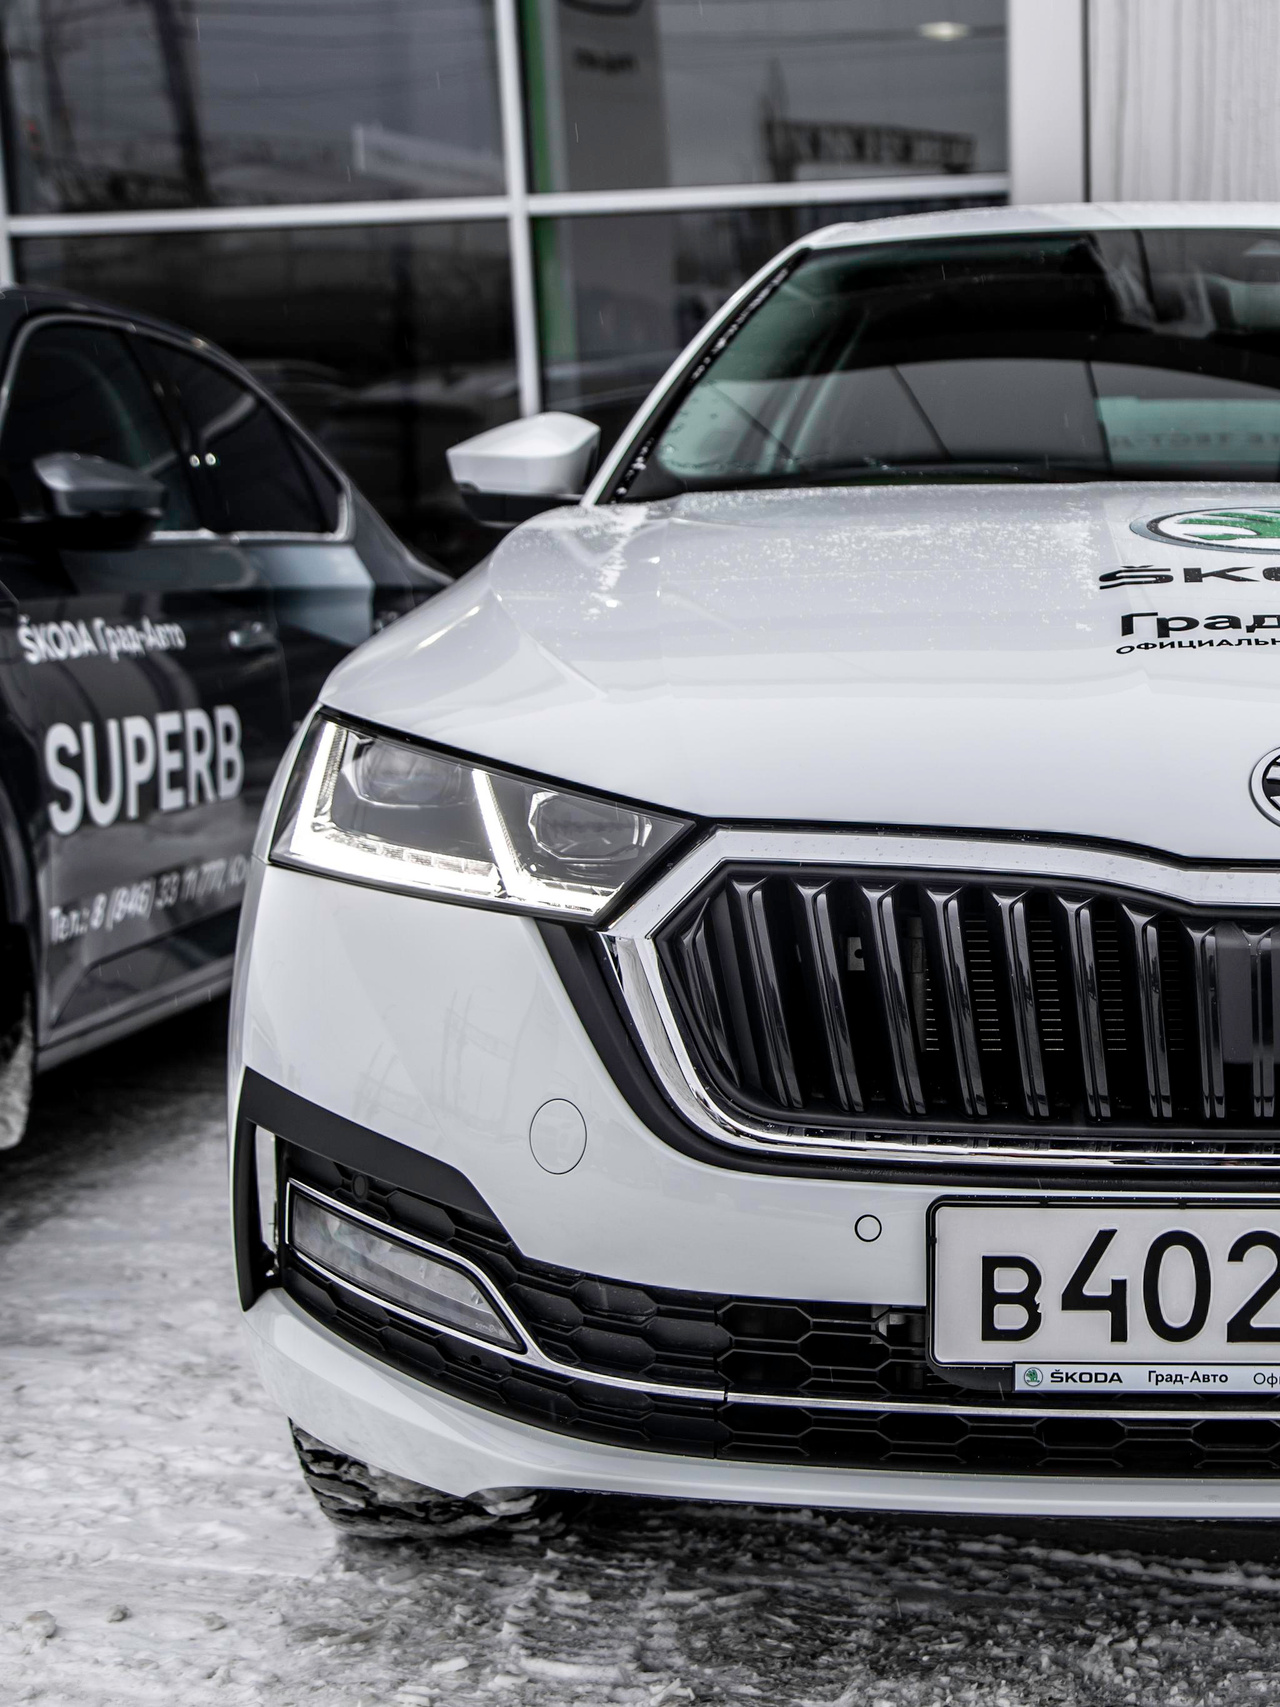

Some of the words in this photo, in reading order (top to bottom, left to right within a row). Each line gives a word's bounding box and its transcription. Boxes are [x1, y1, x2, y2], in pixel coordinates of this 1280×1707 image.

[17, 614, 98, 664] ŠKODA
[92, 615, 187, 663] Град-Авто
[44, 704, 245, 835] SUPERB
[1050, 1369, 1123, 1384] ŠKODA
[1148, 1370, 1229, 1386] Град-Авто
